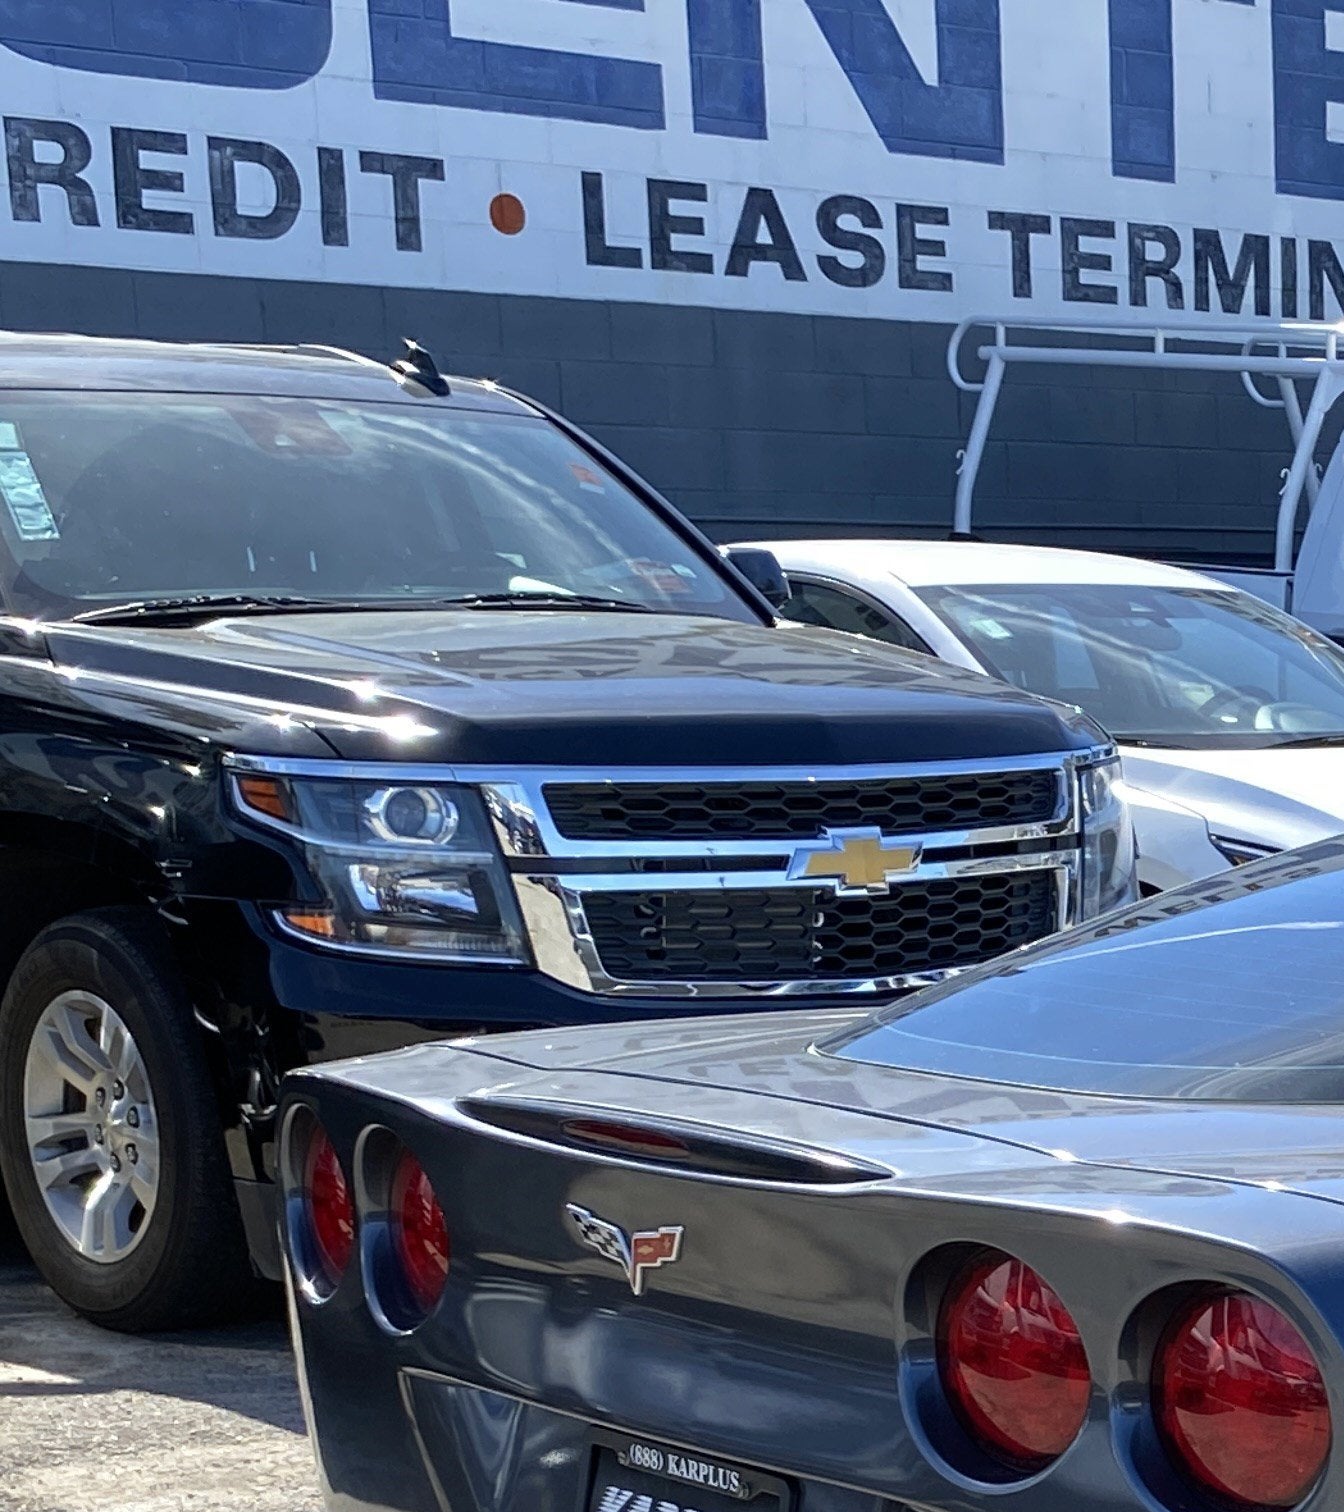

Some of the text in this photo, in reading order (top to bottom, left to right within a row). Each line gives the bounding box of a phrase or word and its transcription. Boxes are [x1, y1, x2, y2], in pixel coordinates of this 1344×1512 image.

[580, 170, 954, 293] LEASE
[628, 1443, 741, 1493] (888) KARPLUS
